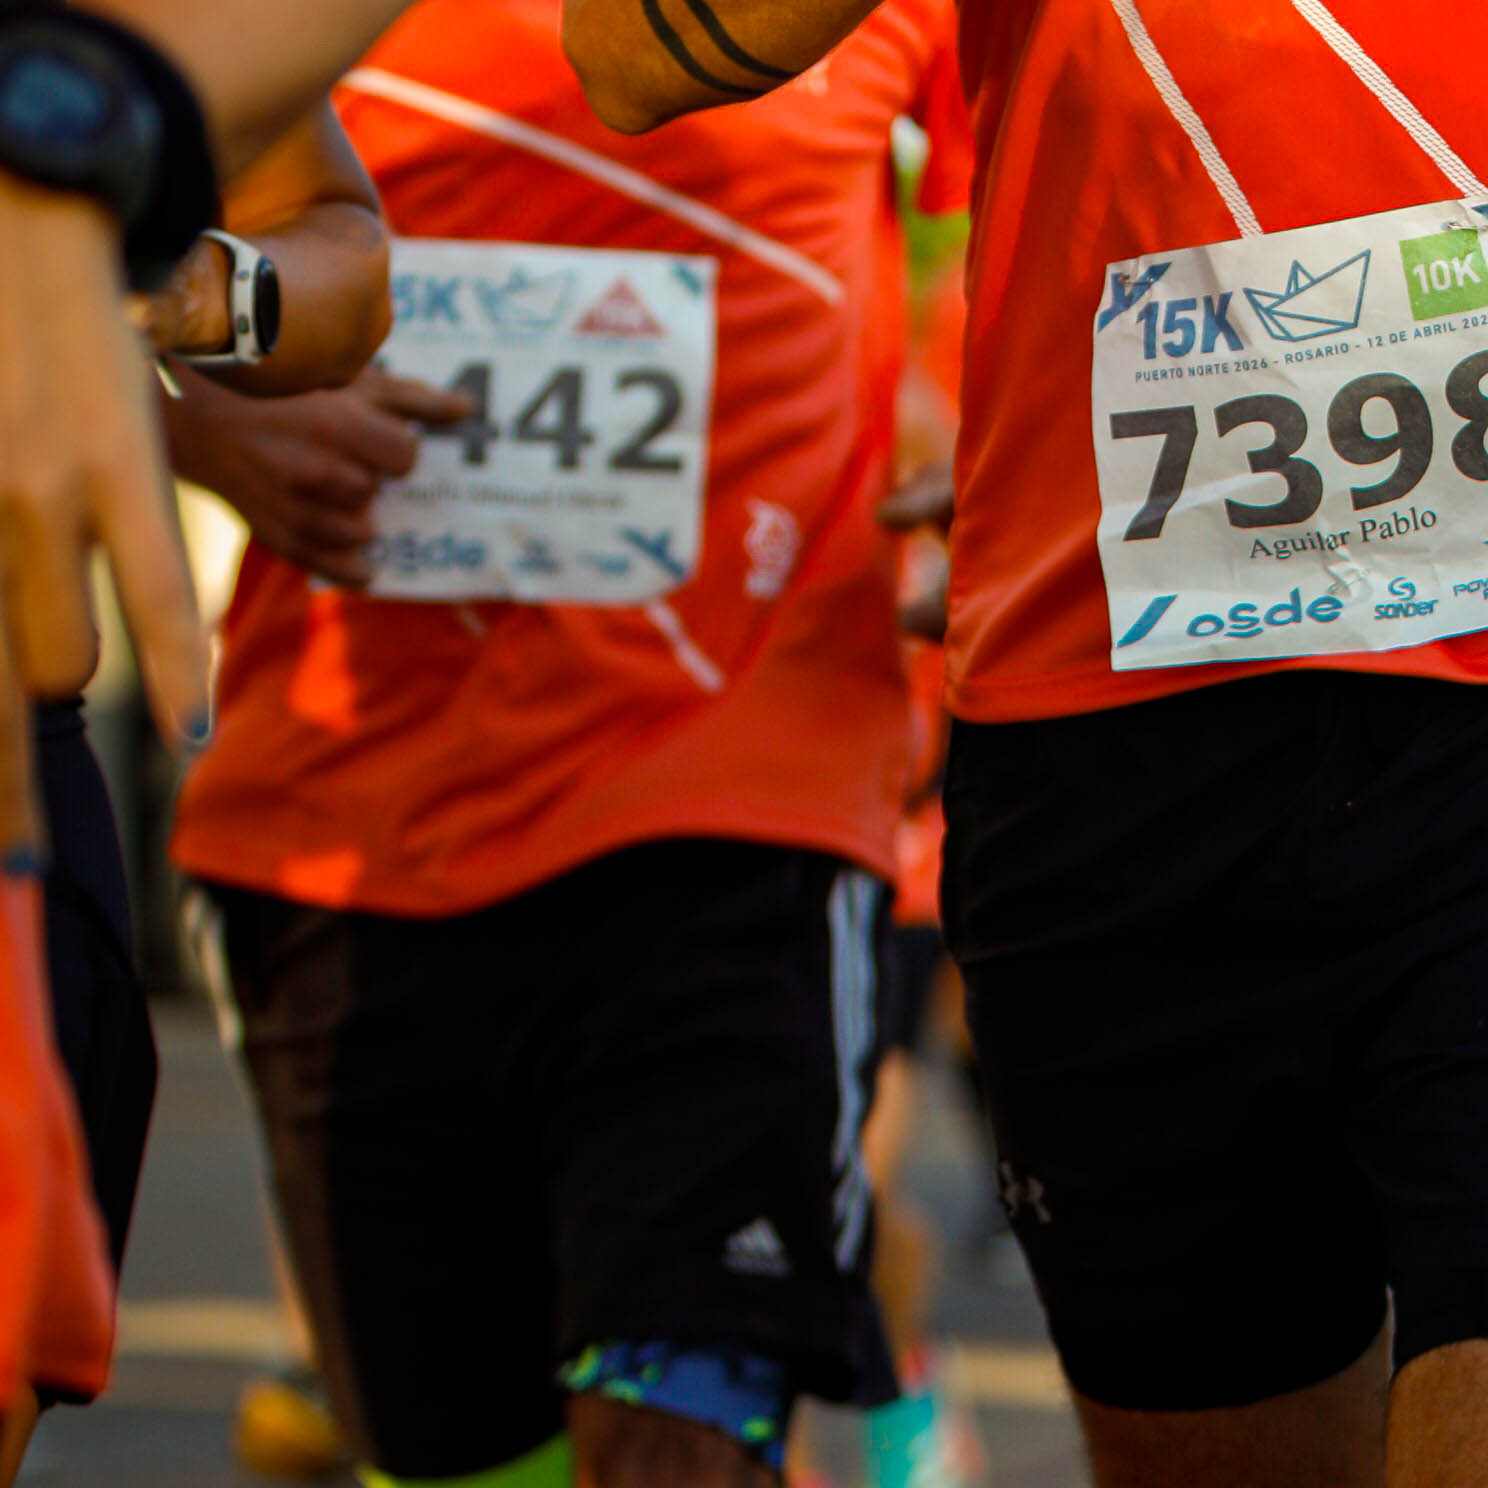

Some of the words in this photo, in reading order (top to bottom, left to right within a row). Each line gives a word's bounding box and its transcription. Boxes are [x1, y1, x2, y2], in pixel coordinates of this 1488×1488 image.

[391, 274, 460, 324] 5K
[1413, 252, 1481, 294] 10K
[1135, 367, 1183, 383] PUERTO
[1188, 362, 1229, 377] NORTE
[1234, 358, 1268, 372] 2026
[1284, 342, 1350, 364] ROSARIO
[1367, 335, 1384, 349] 12
[1389, 330, 1407, 344] DE
[1413, 320, 1457, 340] ABRIL
[1136, 291, 1244, 360] 15K
[416, 359, 686, 475] 442
[1250, 530, 1351, 560] Aguilar
[1359, 506, 1437, 543] Pablo
[1186, 586, 1344, 638] osde
